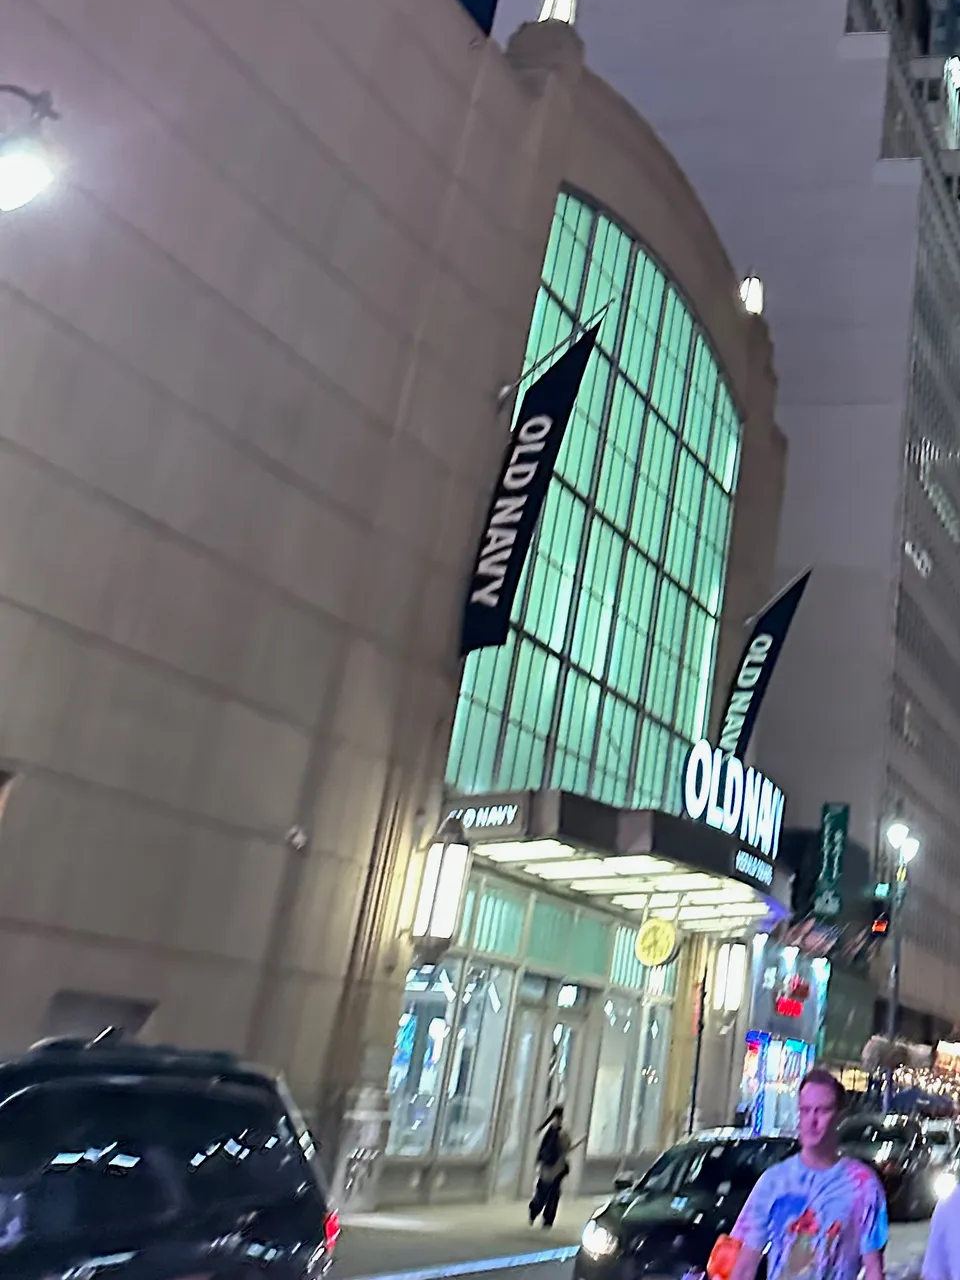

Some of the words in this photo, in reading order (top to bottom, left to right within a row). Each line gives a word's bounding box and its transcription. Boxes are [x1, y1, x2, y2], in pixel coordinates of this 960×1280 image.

[503, 414, 552, 491] OLD
[471, 494, 528, 608] NAVY
[737, 634, 774, 688] OLD
[475, 804, 519, 828] NAVY
[685, 738, 743, 835] OLD
